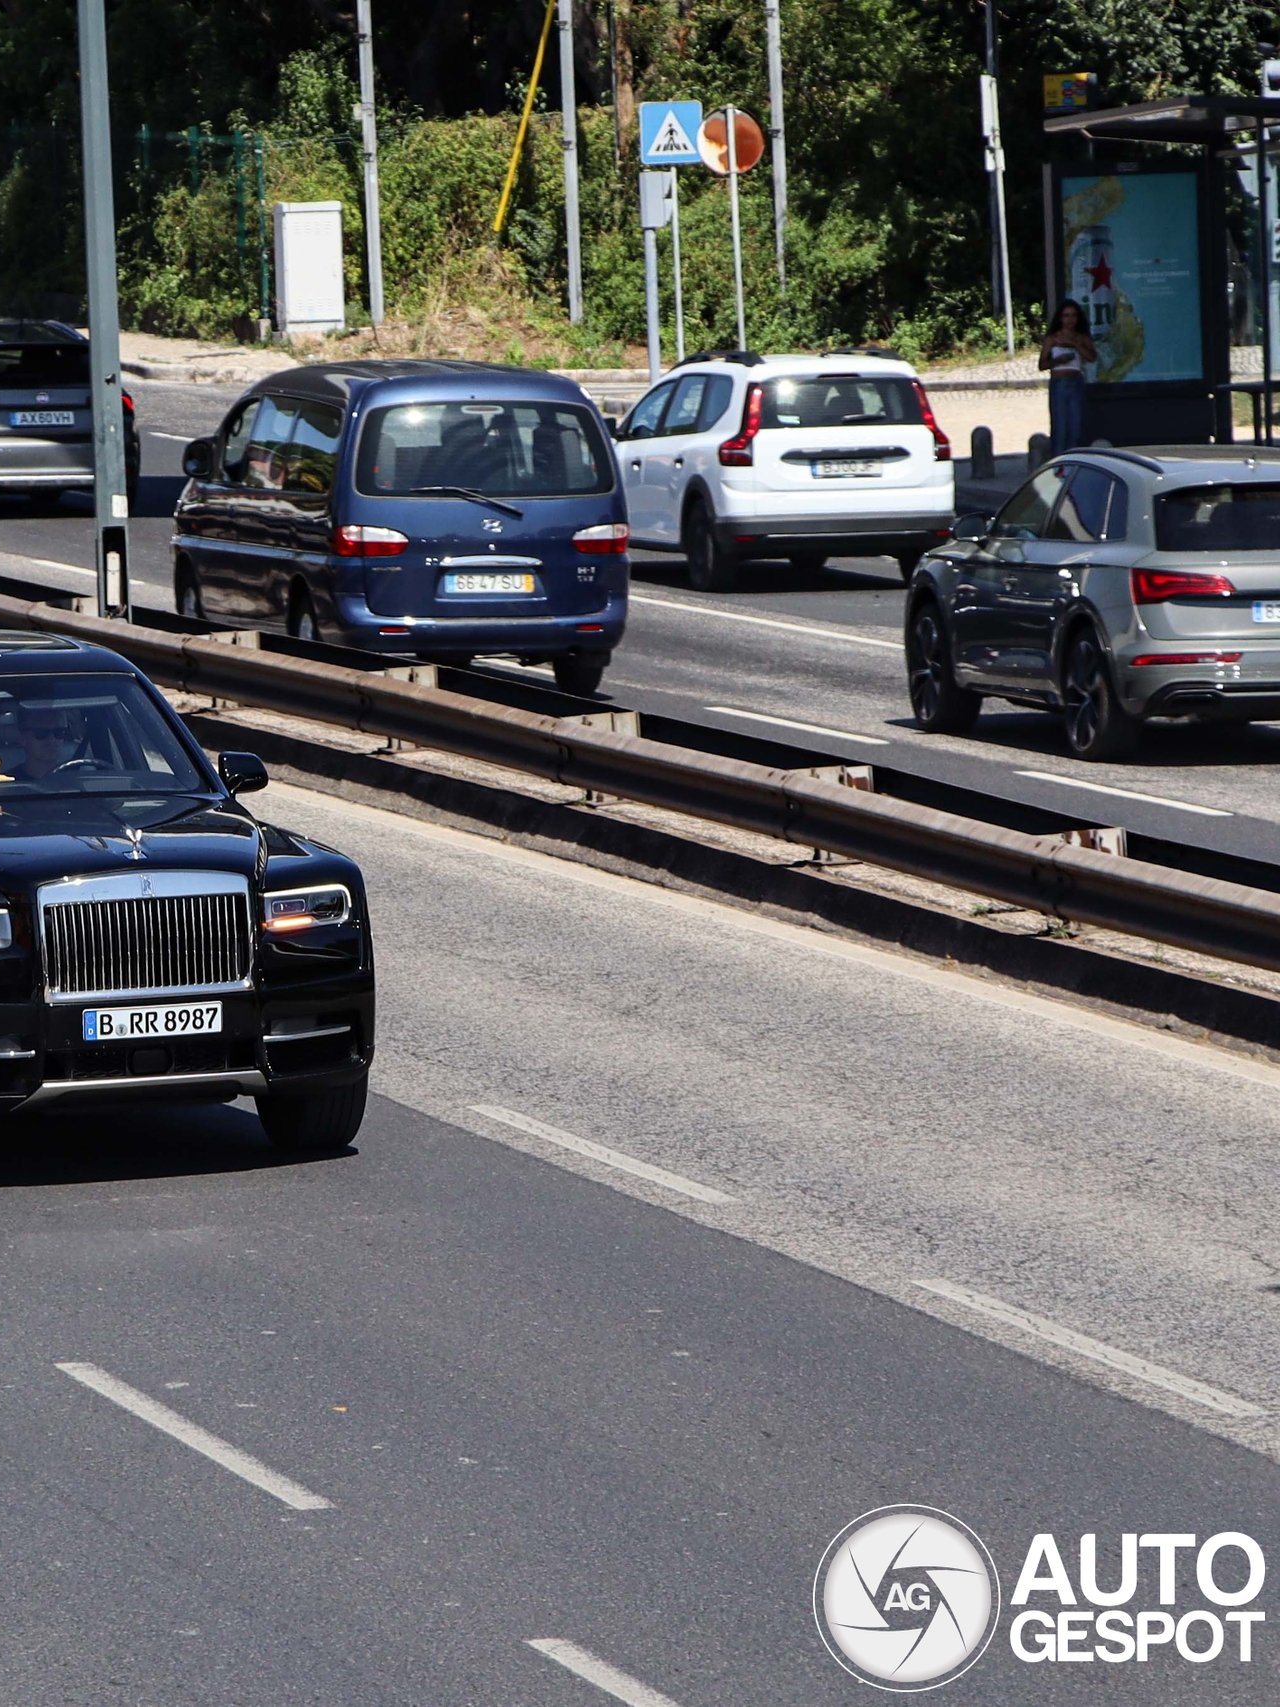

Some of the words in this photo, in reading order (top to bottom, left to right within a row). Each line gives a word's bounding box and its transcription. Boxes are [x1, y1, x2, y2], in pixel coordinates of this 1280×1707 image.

[99, 1013, 115, 1036] B
[129, 1011, 159, 1035] RR
[163, 1007, 219, 1032] 8987
